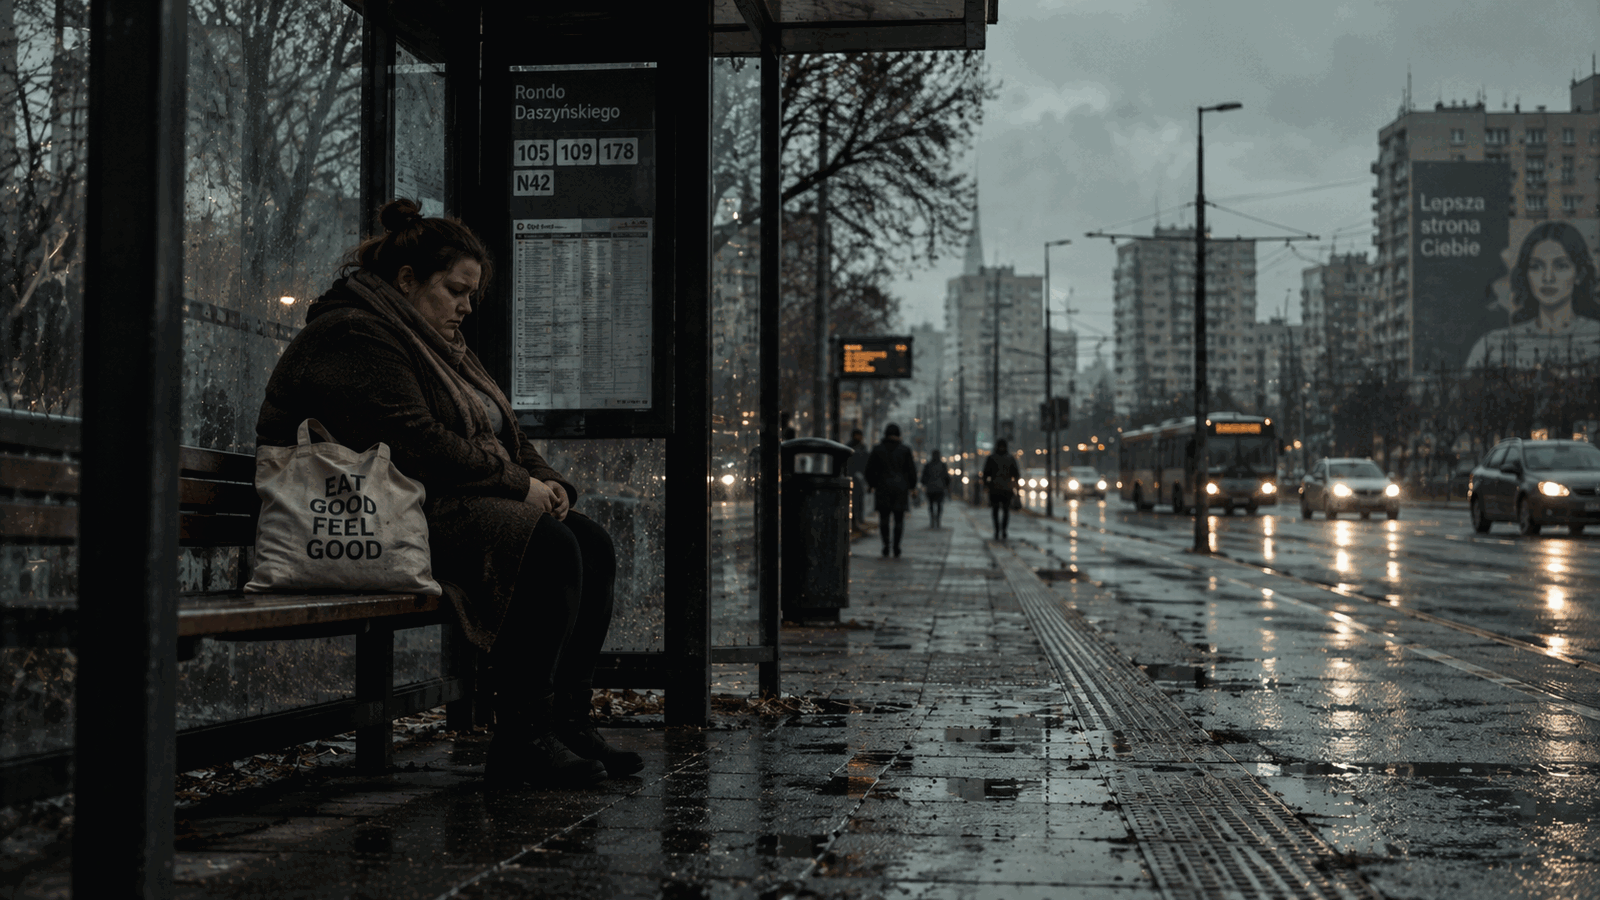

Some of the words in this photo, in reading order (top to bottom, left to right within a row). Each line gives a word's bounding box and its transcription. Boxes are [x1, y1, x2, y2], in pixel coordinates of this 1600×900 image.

[515, 83, 566, 100] Rondo
[515, 103, 621, 123] Daszyńskiego
[518, 144, 550, 161] 105
[561, 143, 592, 160] 109
[603, 142, 634, 160] 178
[517, 174, 550, 191] N42
[1420, 193, 1485, 215] Lepsza
[1420, 218, 1481, 235] strona
[1420, 237, 1481, 257] Ciebie
[325, 473, 366, 497] EAT
[310, 495, 377, 515] GOOD
[313, 516, 374, 536] FEEL
[306, 539, 382, 560] GOOD
